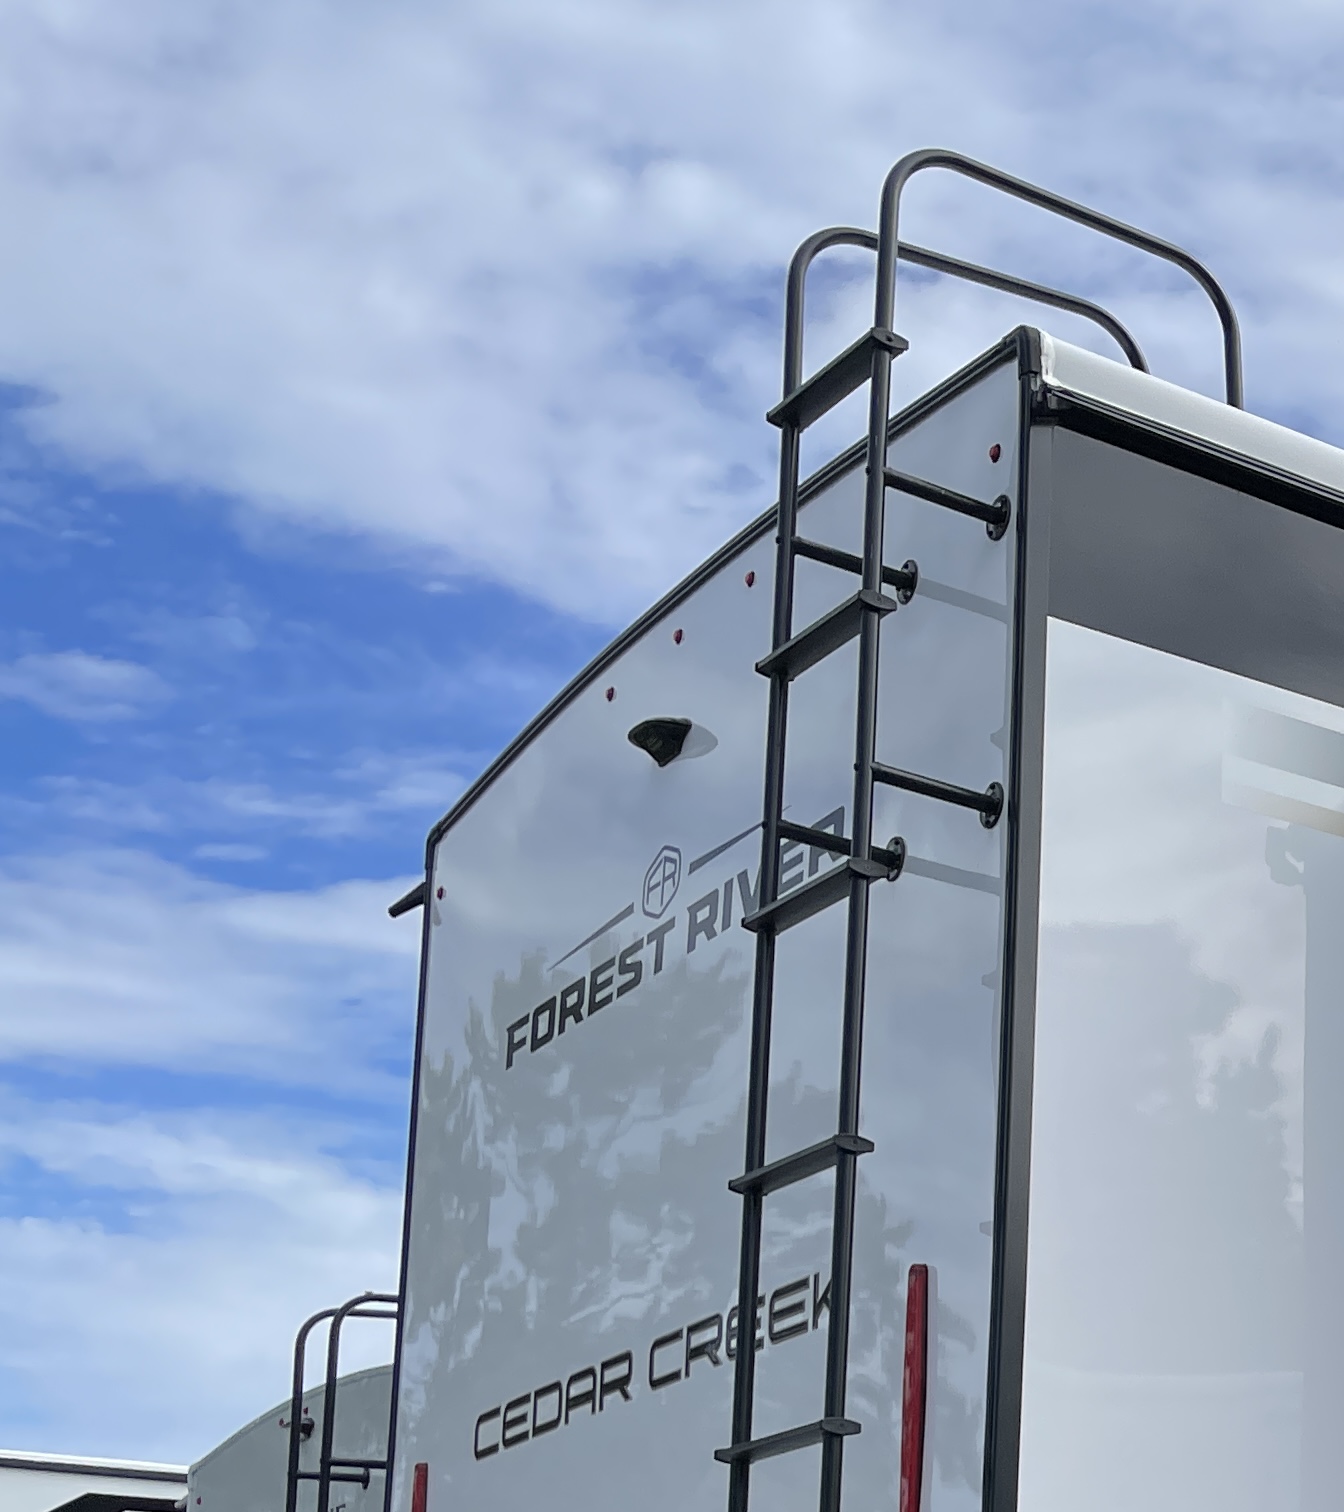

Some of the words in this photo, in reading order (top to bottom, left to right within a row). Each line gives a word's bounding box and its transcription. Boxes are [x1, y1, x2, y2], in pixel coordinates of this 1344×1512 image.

[504, 915, 676, 1071] FOREST
[686, 805, 845, 954] RIVER
[473, 1349, 633, 1461] CEDAR
